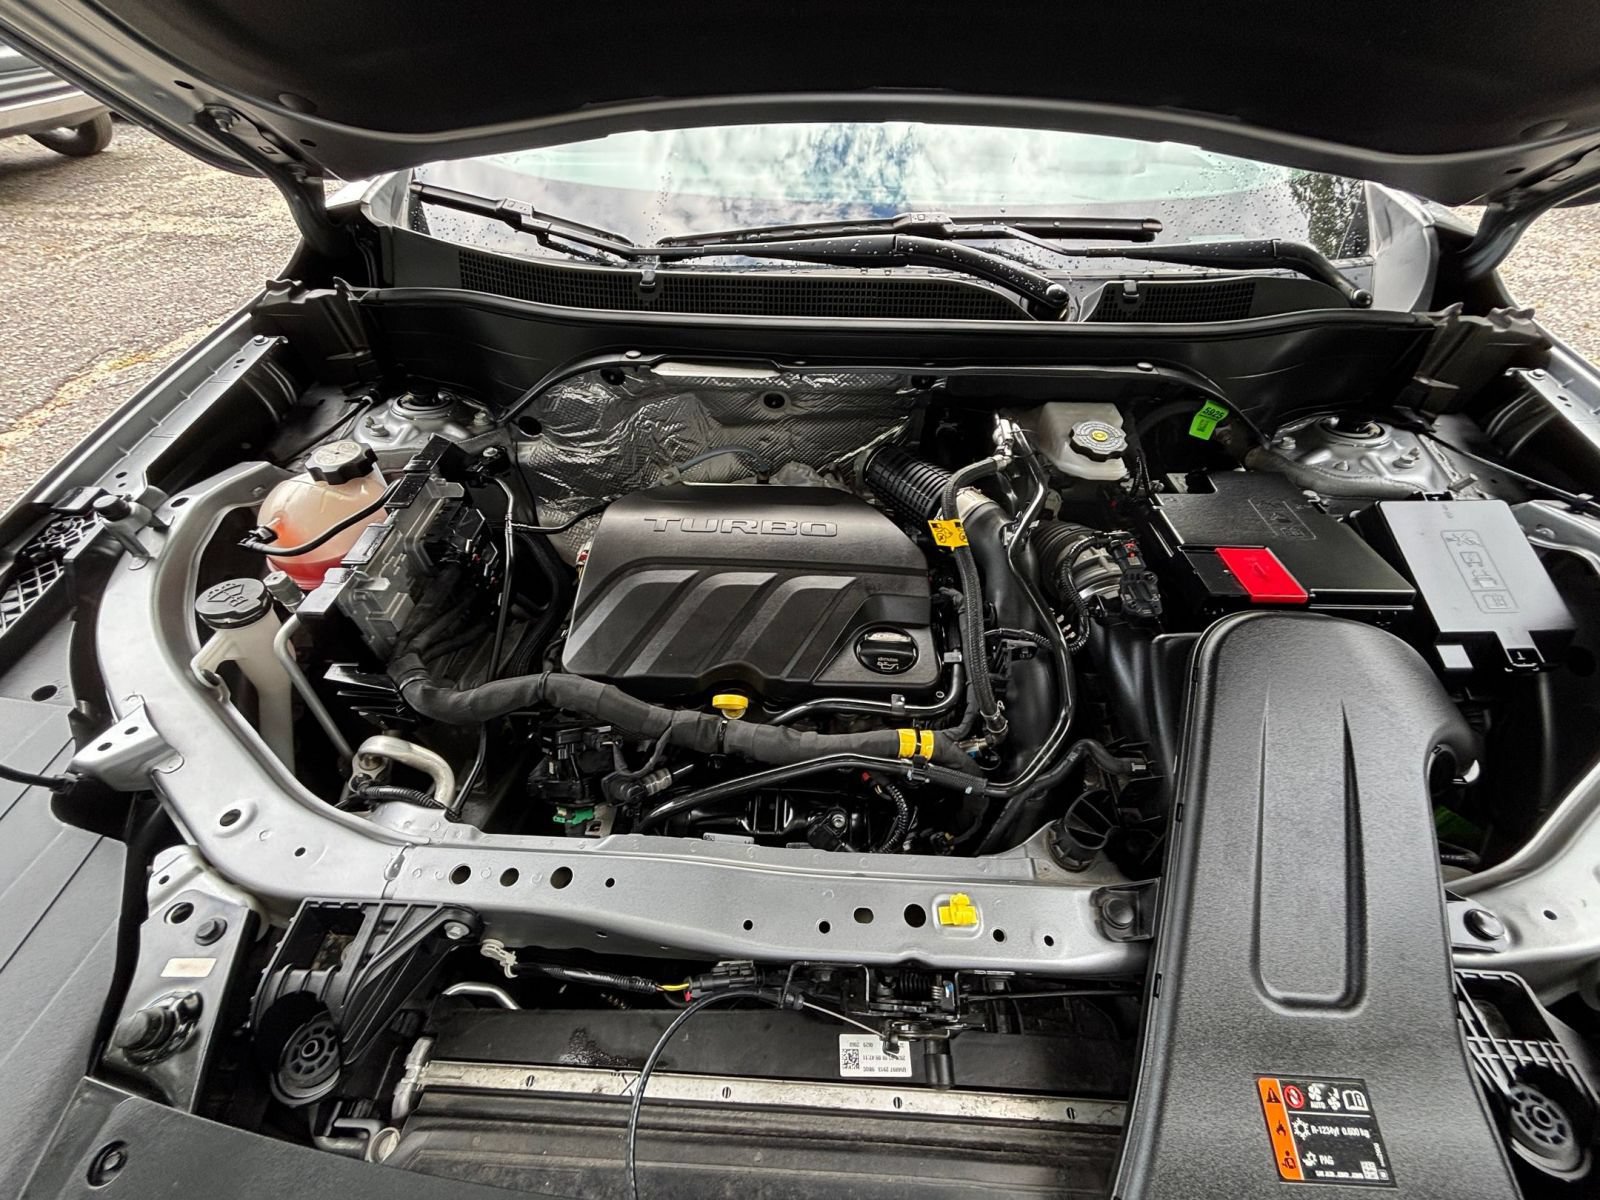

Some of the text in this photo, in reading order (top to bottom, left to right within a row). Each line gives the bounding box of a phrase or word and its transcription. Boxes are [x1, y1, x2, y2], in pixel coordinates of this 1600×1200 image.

[1203, 406, 1225, 419] 5925
[643, 517, 838, 537] TURBO
[1318, 1154, 1335, 1165] PAG
